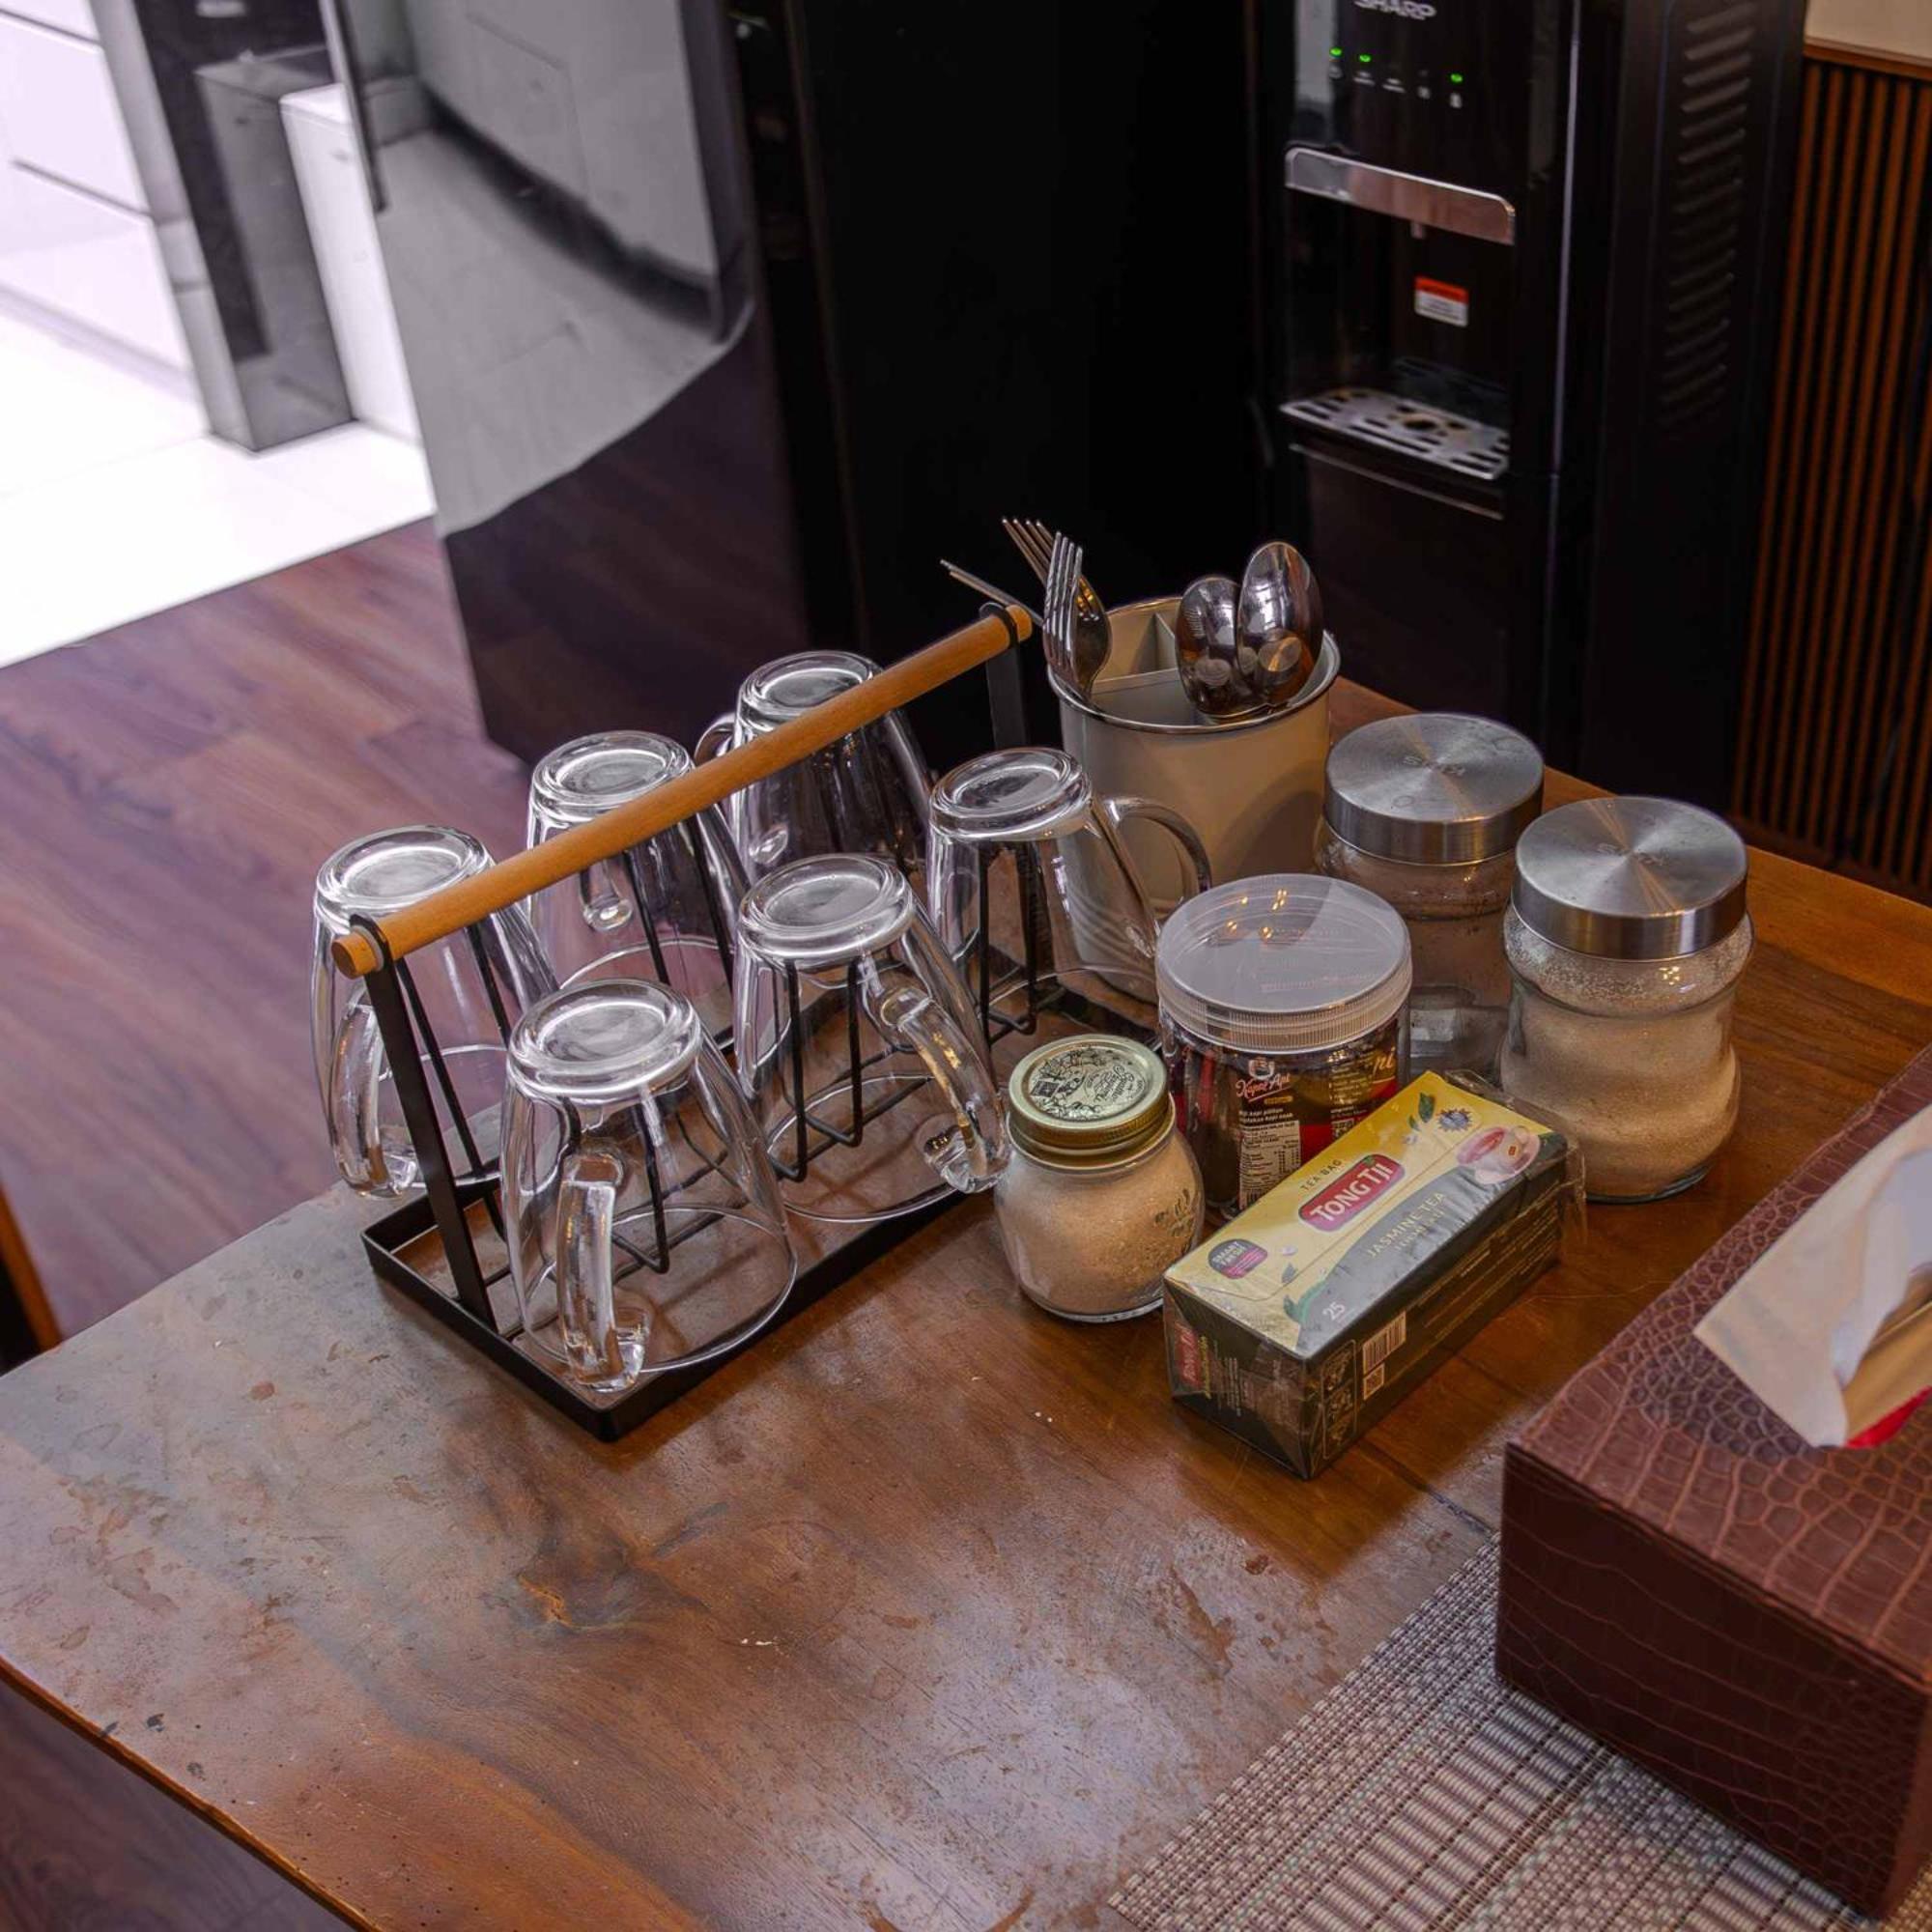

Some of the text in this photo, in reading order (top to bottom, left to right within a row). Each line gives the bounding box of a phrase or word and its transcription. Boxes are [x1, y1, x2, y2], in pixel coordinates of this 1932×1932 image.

[1300, 1159, 1343, 1191] TEA BAG
[1310, 1162, 1394, 1222] TONG TJI
[1367, 1213, 1423, 1257] JASMINE
[1417, 1192, 1445, 1212] TEA
[1322, 1301, 1346, 1321] 25
